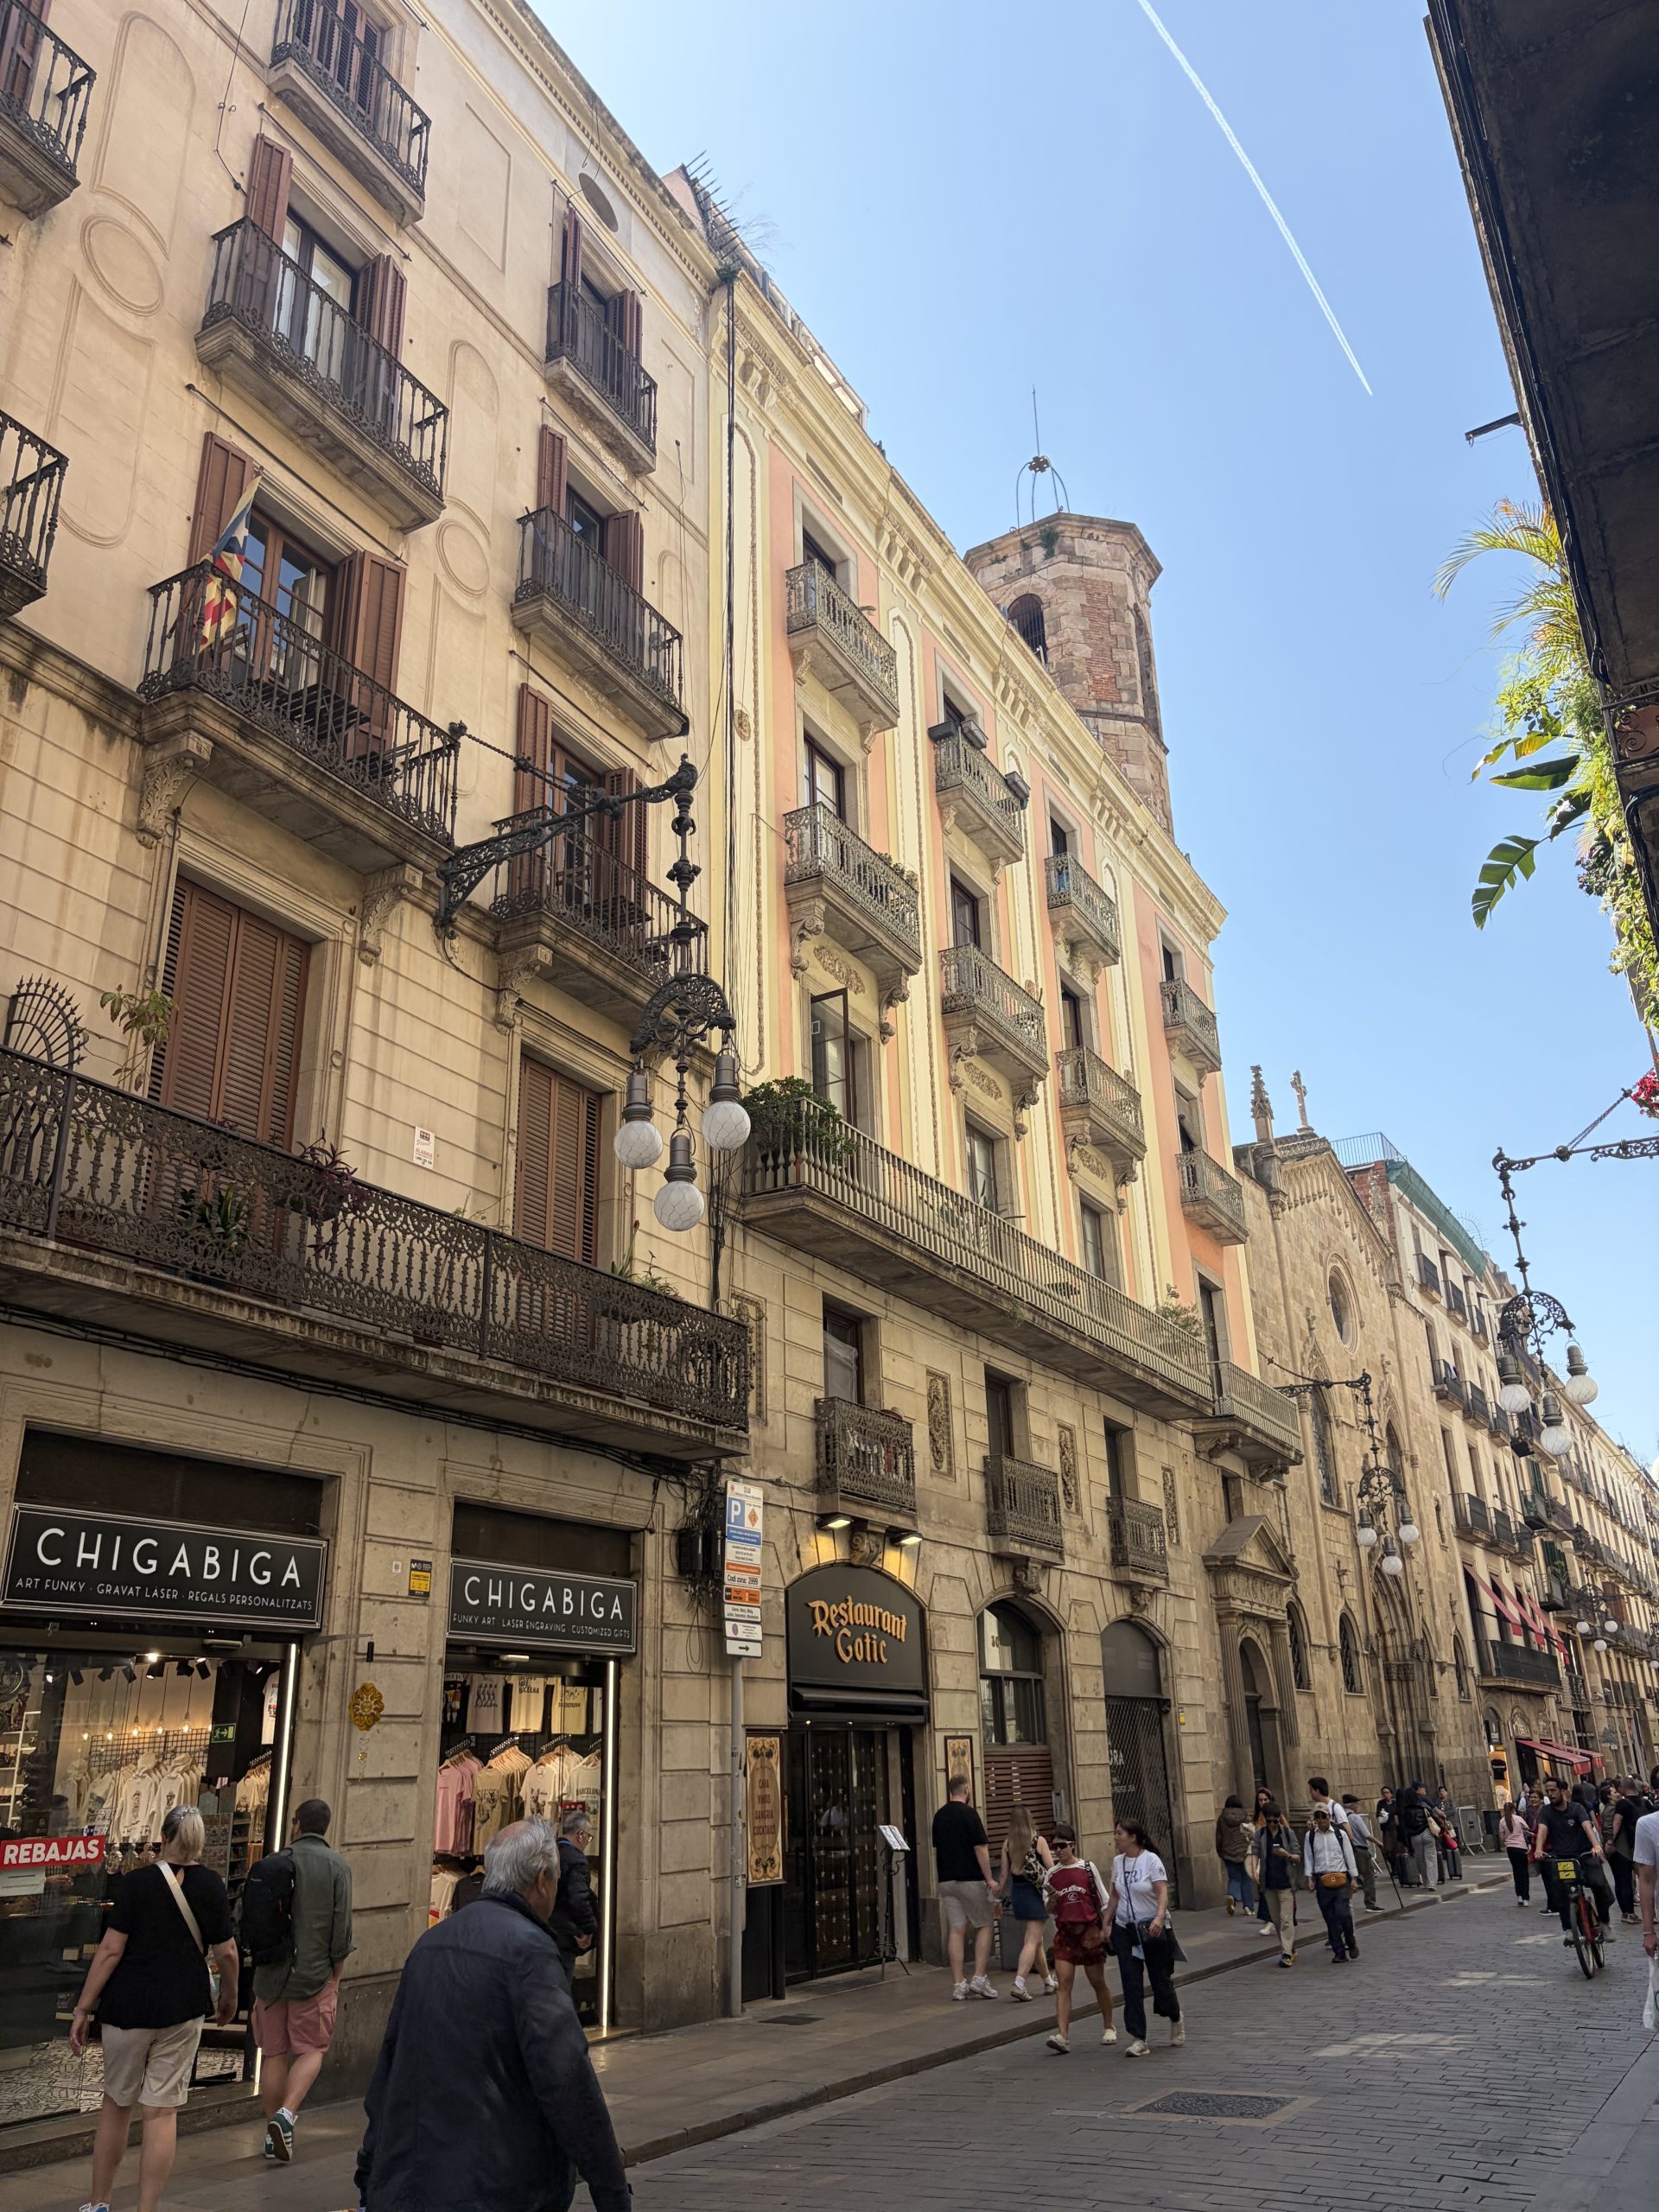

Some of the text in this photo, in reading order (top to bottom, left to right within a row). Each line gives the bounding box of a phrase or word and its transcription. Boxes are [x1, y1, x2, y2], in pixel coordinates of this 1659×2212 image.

[730, 1499, 741, 1523] P
[36, 1528, 301, 1588] CHIGABIGA
[16, 1577, 41, 1589] ART
[44, 1579, 86, 1592] FUNKY
[97, 1583, 141, 1597] GRAVAT
[188, 1590, 226, 1604] REGALS
[229, 1593, 313, 1611] PERSONALITZATS
[464, 1576, 623, 1621] CHIGABIGA
[453, 1613, 630, 1639] FUNKY ART LASER ENGRAVING CUSTOMIZED GIFTS
[807, 1595, 906, 1643] Restaurant
[836, 1628, 887, 1664] Gotic
[3, 1839, 99, 1866] REBAJAS
